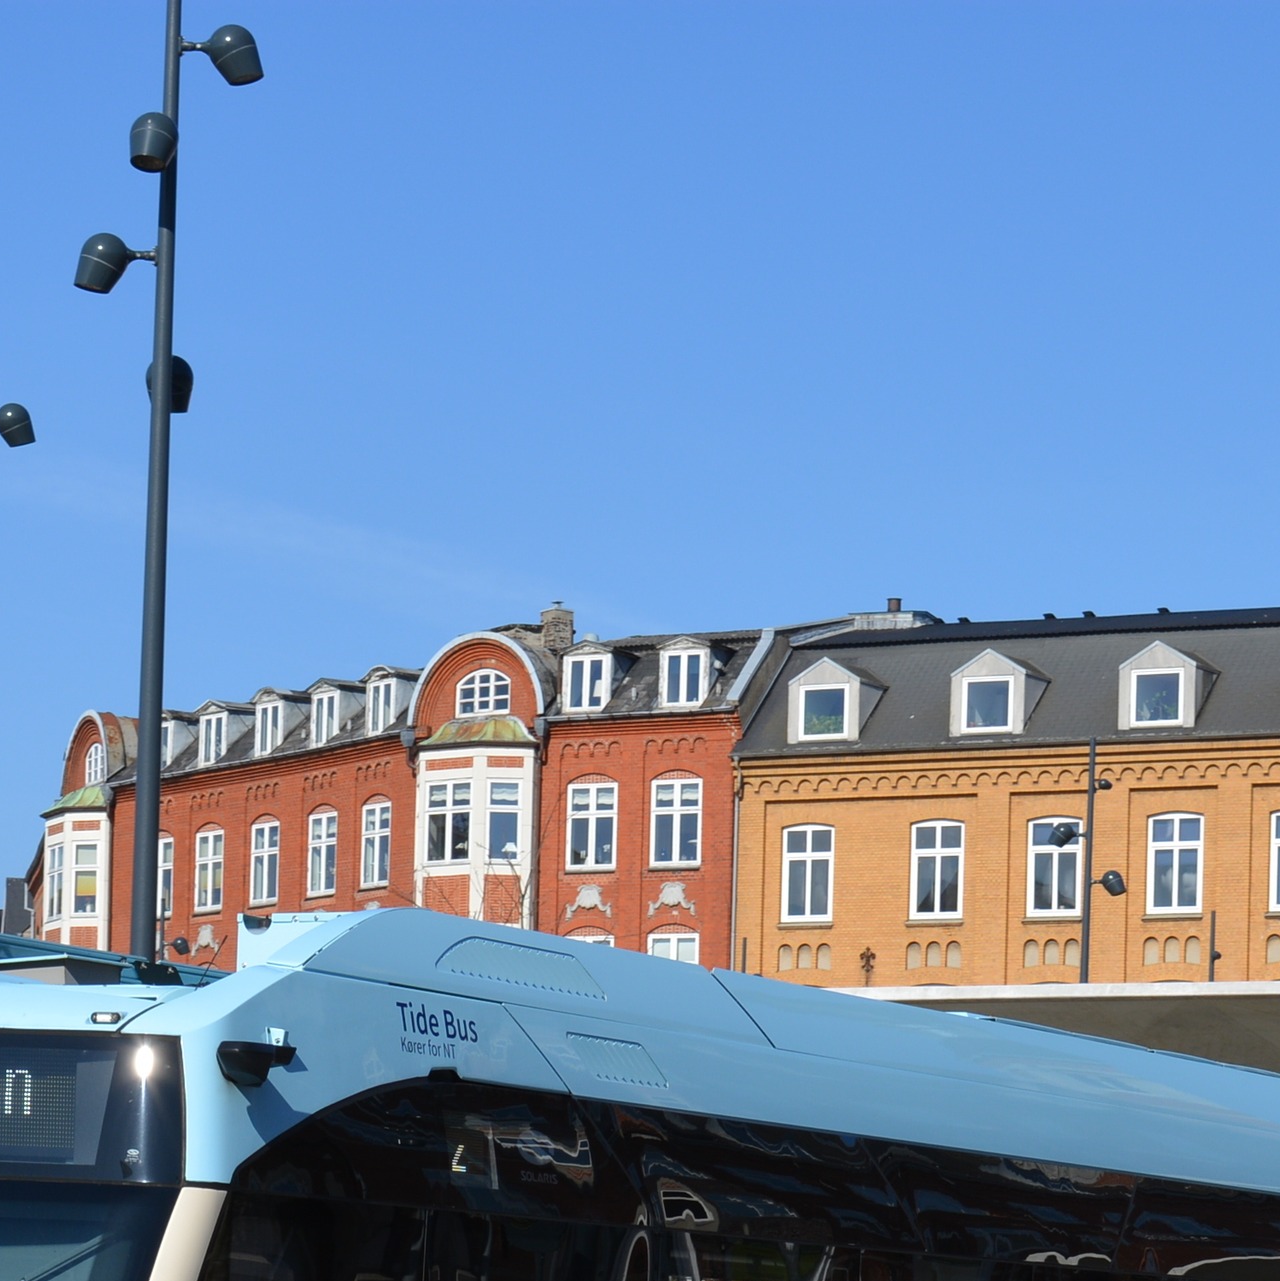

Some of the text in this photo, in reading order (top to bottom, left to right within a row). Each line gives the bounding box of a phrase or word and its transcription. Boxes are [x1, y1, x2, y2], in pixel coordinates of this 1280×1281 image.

[396, 1001, 478, 1043] Tide Bus
[400, 1036, 456, 1059] Kører for NT
[521, 1170, 559, 1185] SOLARIS
